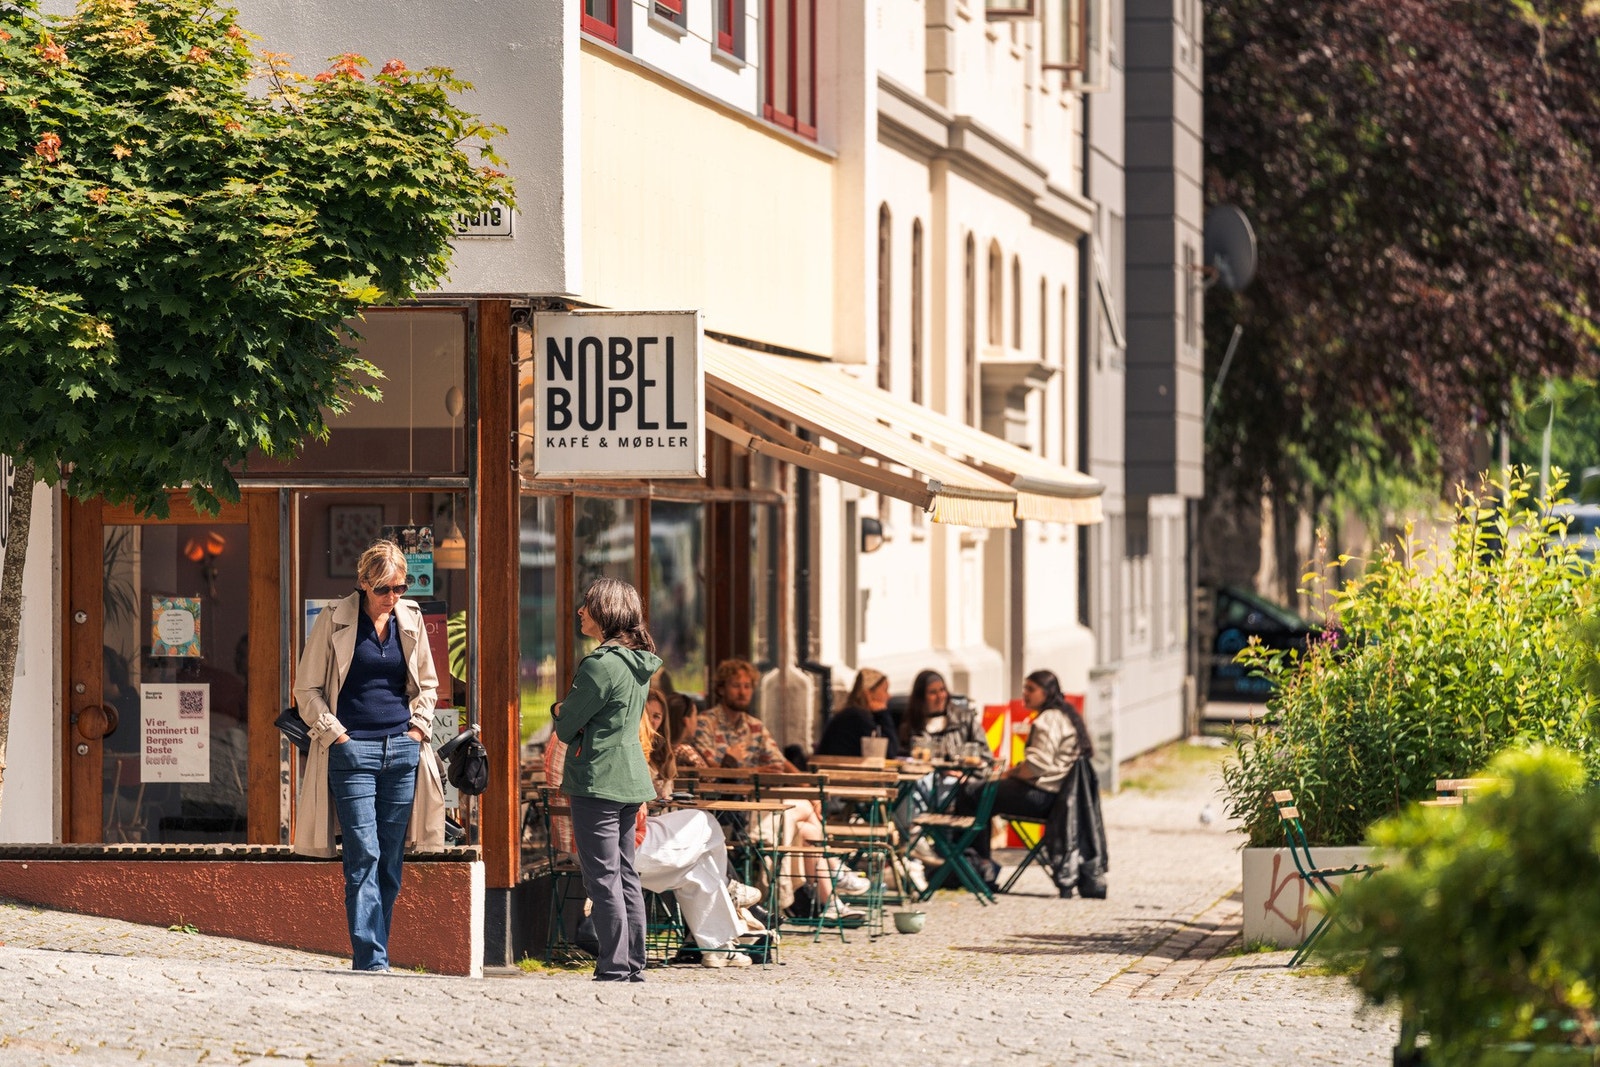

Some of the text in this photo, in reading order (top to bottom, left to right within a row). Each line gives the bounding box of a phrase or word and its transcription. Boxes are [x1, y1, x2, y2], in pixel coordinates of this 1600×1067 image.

[546, 434, 688, 449] KAFÉ & MØBLER
[145, 718, 155, 727] Vi
[146, 726, 199, 735] nominert til
[146, 736, 184, 746] Bergens
[146, 746, 172, 754] Beste
[145, 755, 178, 766] kaffe
